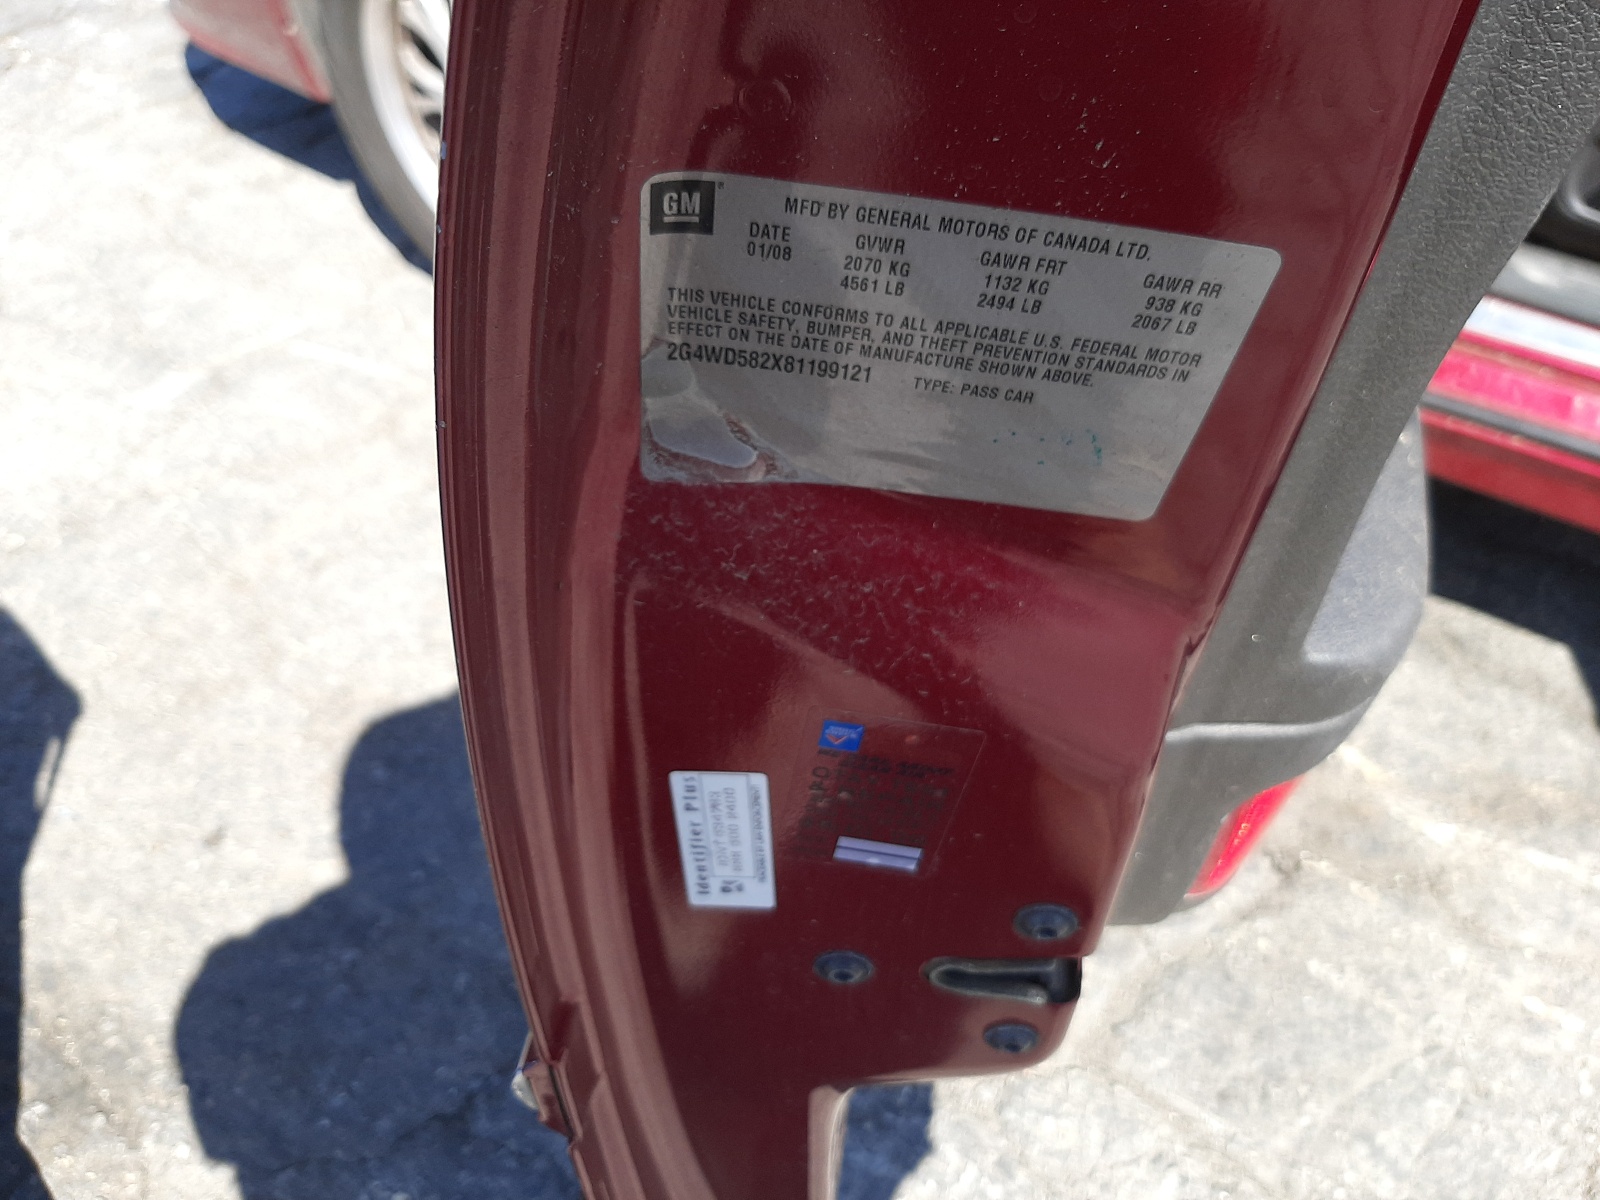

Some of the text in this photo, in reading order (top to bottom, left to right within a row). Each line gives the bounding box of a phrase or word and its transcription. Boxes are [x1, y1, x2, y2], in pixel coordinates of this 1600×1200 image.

[663, 192, 701, 216] GM
[749, 222, 791, 242] DATE
[828, 204, 849, 220] BY
[856, 205, 930, 231] GENERAL
[937, 216, 1010, 241] MOTORS
[1015, 227, 1037, 243] OF
[1043, 231, 1110, 254] CANADA
[1116, 241, 1151, 260] LTD.
[746, 241, 792, 261] 01/08
[855, 235, 905, 255] GVWR
[843, 256, 911, 277] 2070 KG
[980, 251, 1068, 275] GAWR FRT
[840, 275, 905, 297] 4561 LB
[984, 275, 1049, 295] 1132 KG
[1143, 274, 1222, 298] GAWR RR
[977, 294, 1041, 314] 2494 LB
[1145, 297, 1202, 317] 938 KG
[668, 287, 1201, 367] THIS VEHICLE CONFORMS TO ALL APPLICABLE U.S. FEDERAL MOTOR
[1131, 315, 1197, 335] 2067 LB
[668, 305, 1190, 382] VEHICLE SAFETY, BUMPER, AND THEFT PREVENTION STANDARDS IN
[668, 322, 1094, 387] EFFECT ON THE DATE OF MANUFACTURE SHOWN ABOVE.
[667, 342, 872, 383] 2G4WD582X81199121
[914, 377, 1034, 405] TYPE: PASS CAR
[682, 775, 711, 895] Identifier Plus
